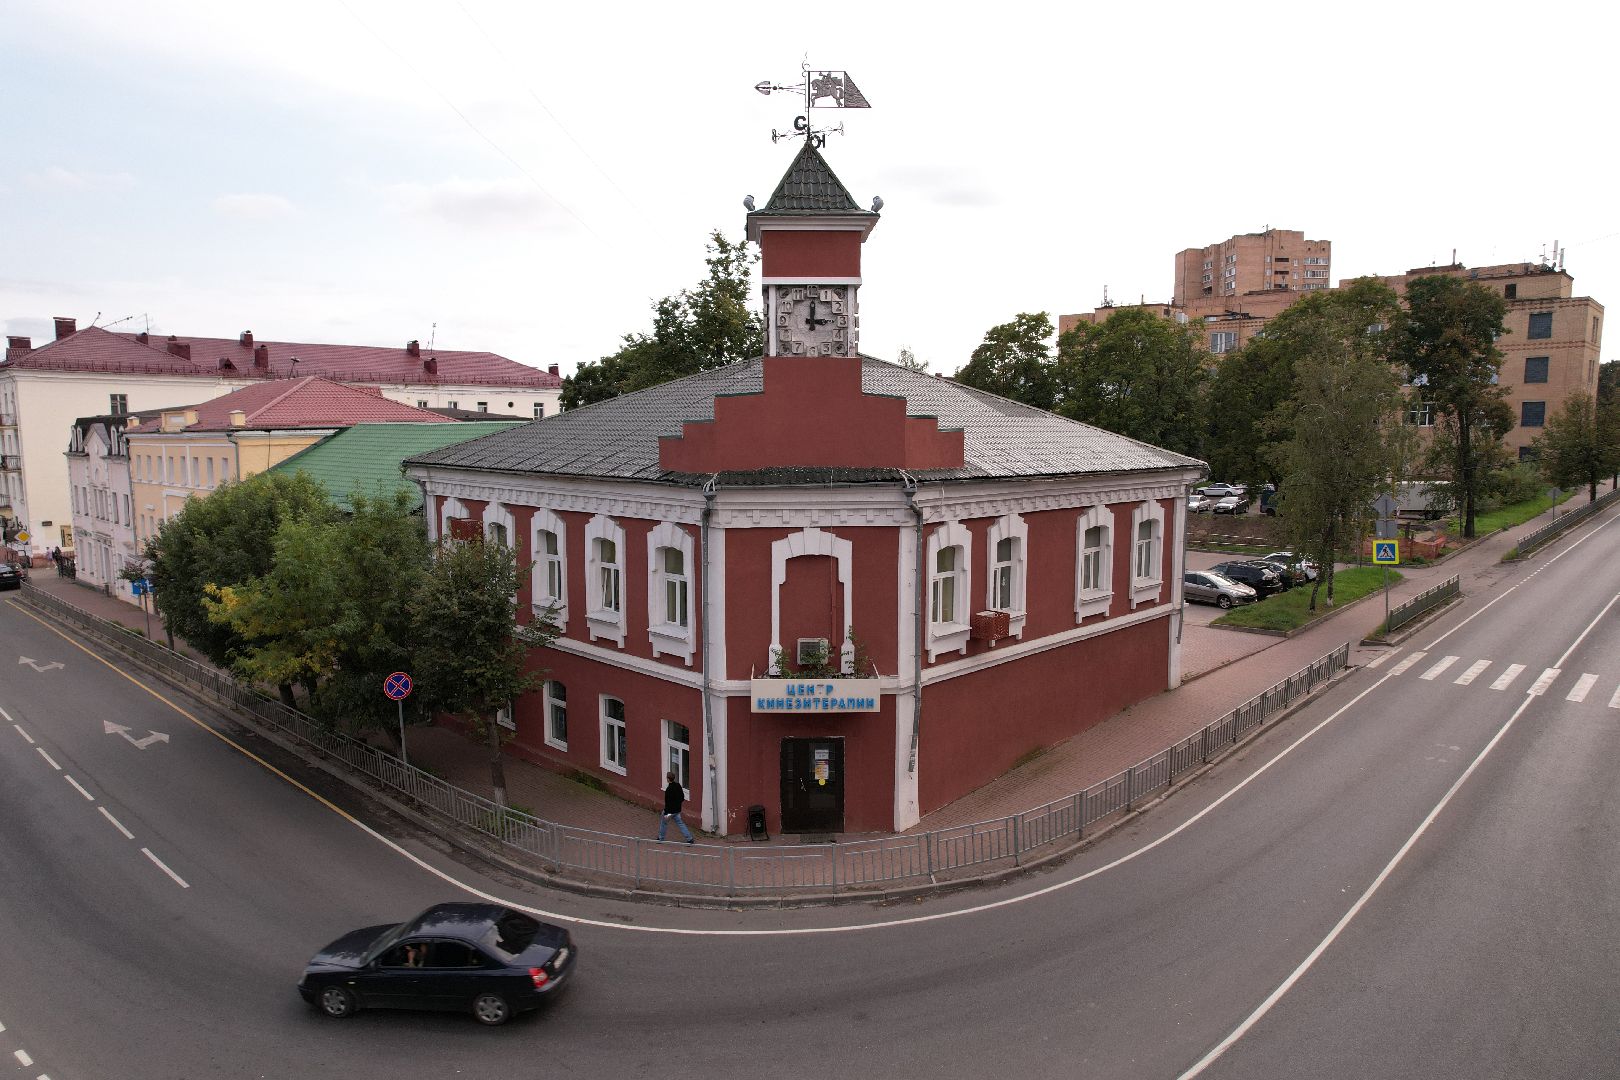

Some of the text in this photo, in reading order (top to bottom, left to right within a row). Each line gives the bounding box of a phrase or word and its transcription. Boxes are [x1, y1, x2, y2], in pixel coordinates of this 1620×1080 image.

[794, 288, 804, 300] 11
[823, 290, 829, 300] 1
[781, 301, 792, 312] 10
[835, 302, 842, 312] 2
[779, 315, 787, 325] 9
[839, 315, 847, 326] 3
[834, 329, 842, 340] 4
[794, 342, 802, 352] 7
[786, 684, 834, 697] ЦЕНТР
[757, 697, 875, 710] КИНЕЗИТЕРАПИИ
